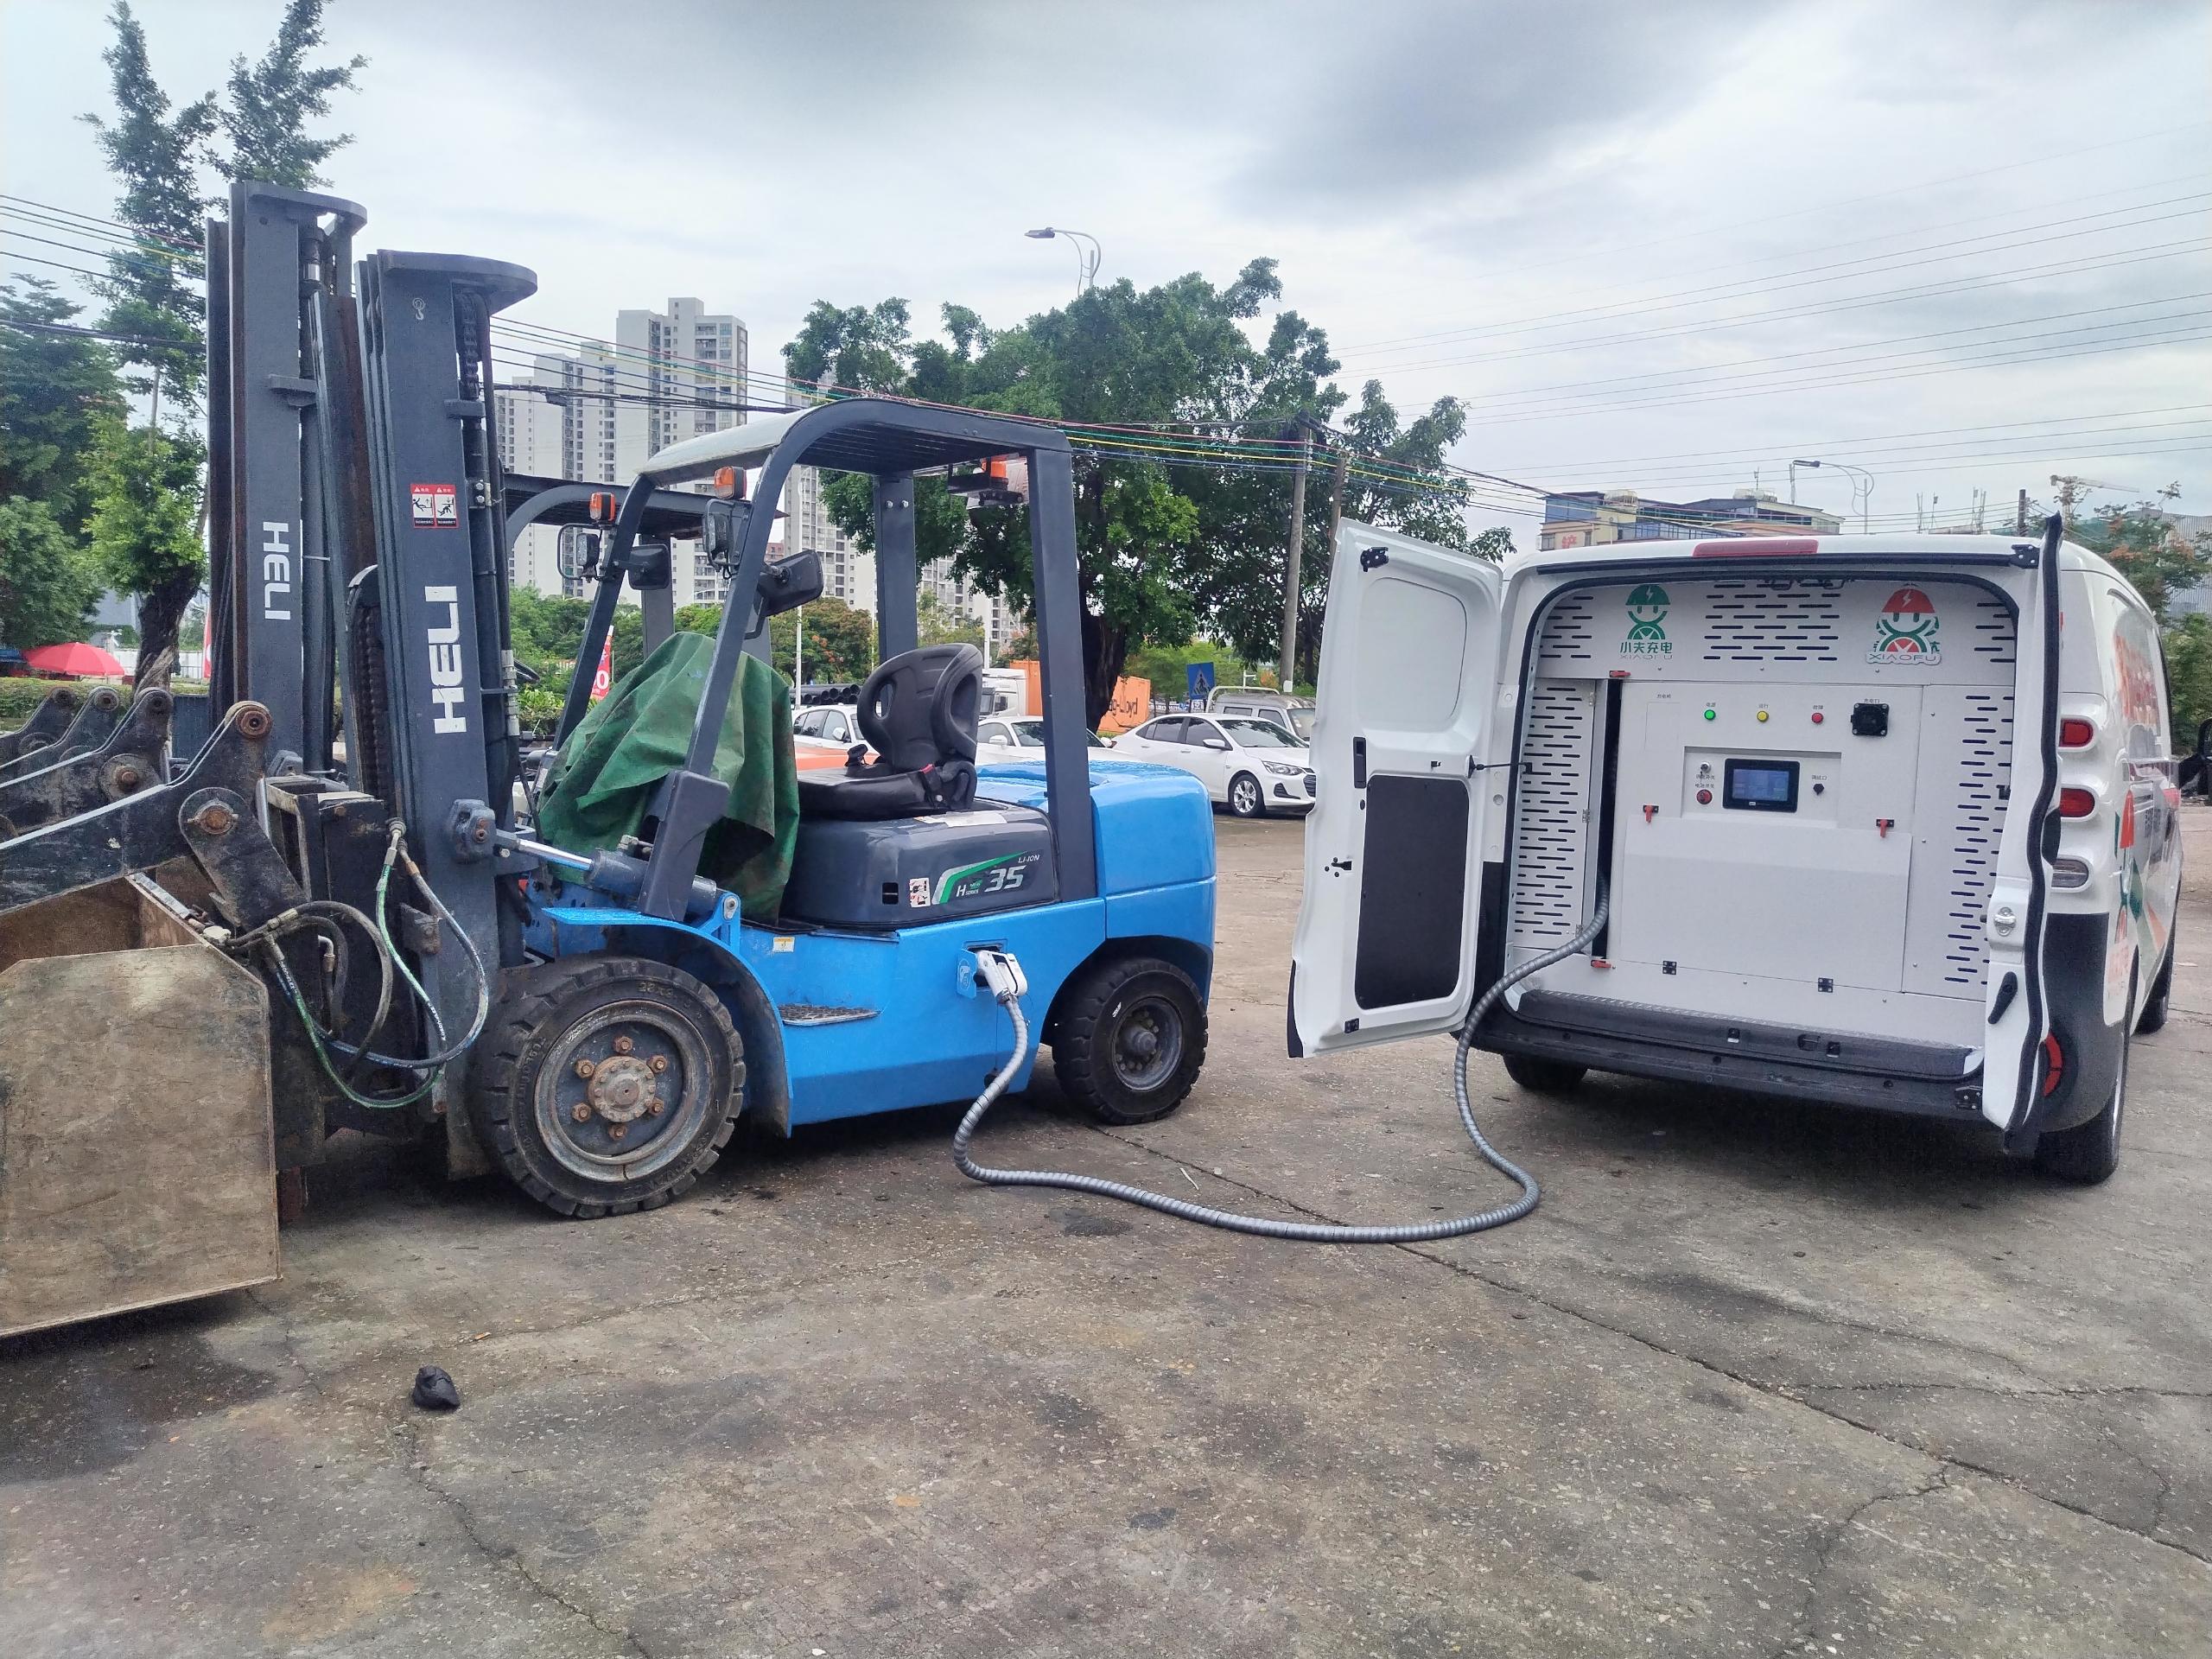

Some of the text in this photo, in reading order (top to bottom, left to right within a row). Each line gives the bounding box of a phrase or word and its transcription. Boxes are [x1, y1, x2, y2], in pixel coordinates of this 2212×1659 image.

[263, 522, 290, 620] HELI
[1620, 642, 1673, 653] 小夫充电
[424, 586, 467, 734] HELI
[1869, 653, 1936, 662] XIAOFU
[1018, 855, 1039, 863] LI-ION
[984, 865, 1027, 893] 35
[956, 884, 967, 897] H
